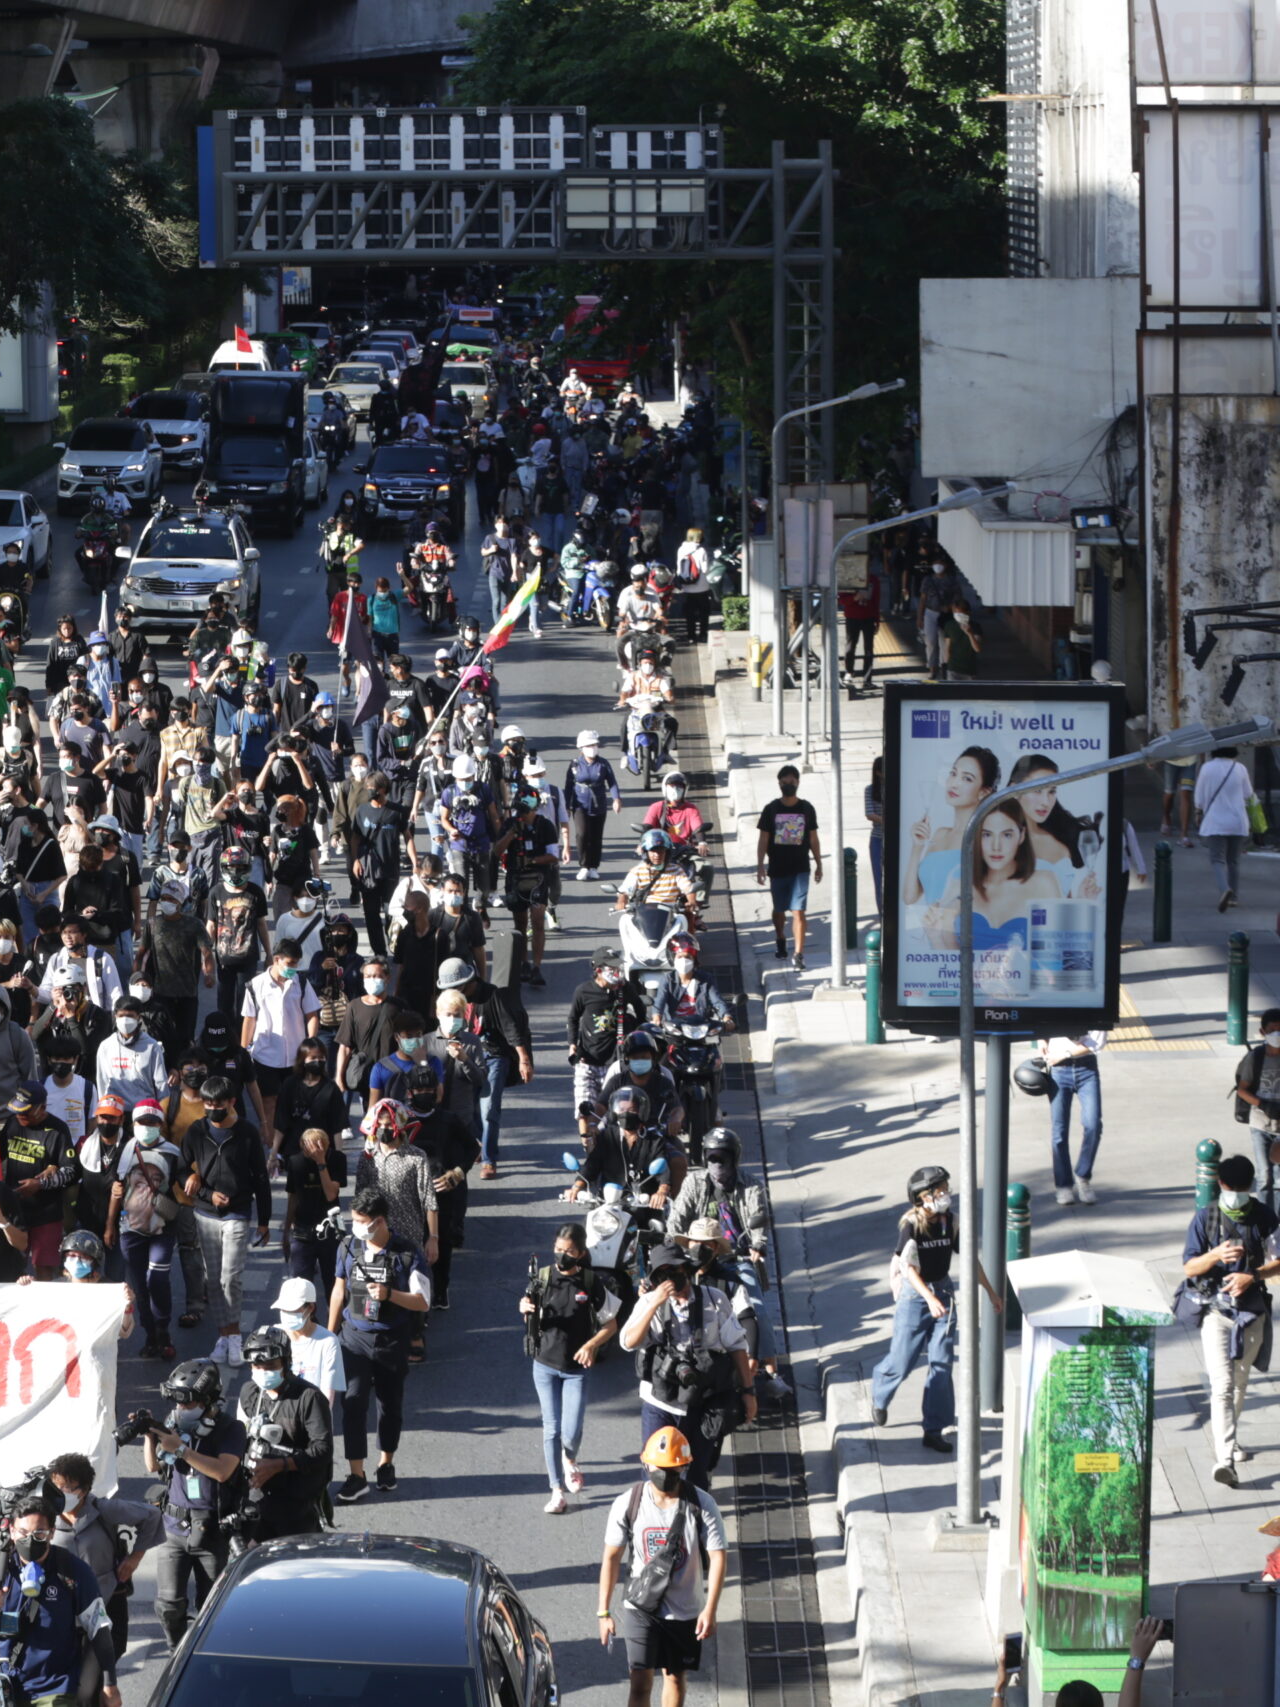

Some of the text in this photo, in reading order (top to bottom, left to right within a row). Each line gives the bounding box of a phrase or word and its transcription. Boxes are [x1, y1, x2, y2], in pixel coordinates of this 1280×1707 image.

[913, 713, 937, 722] well
[959, 709, 1075, 731] ใหม่! well u
[1019, 737, 1101, 751] คอลลาเจน
